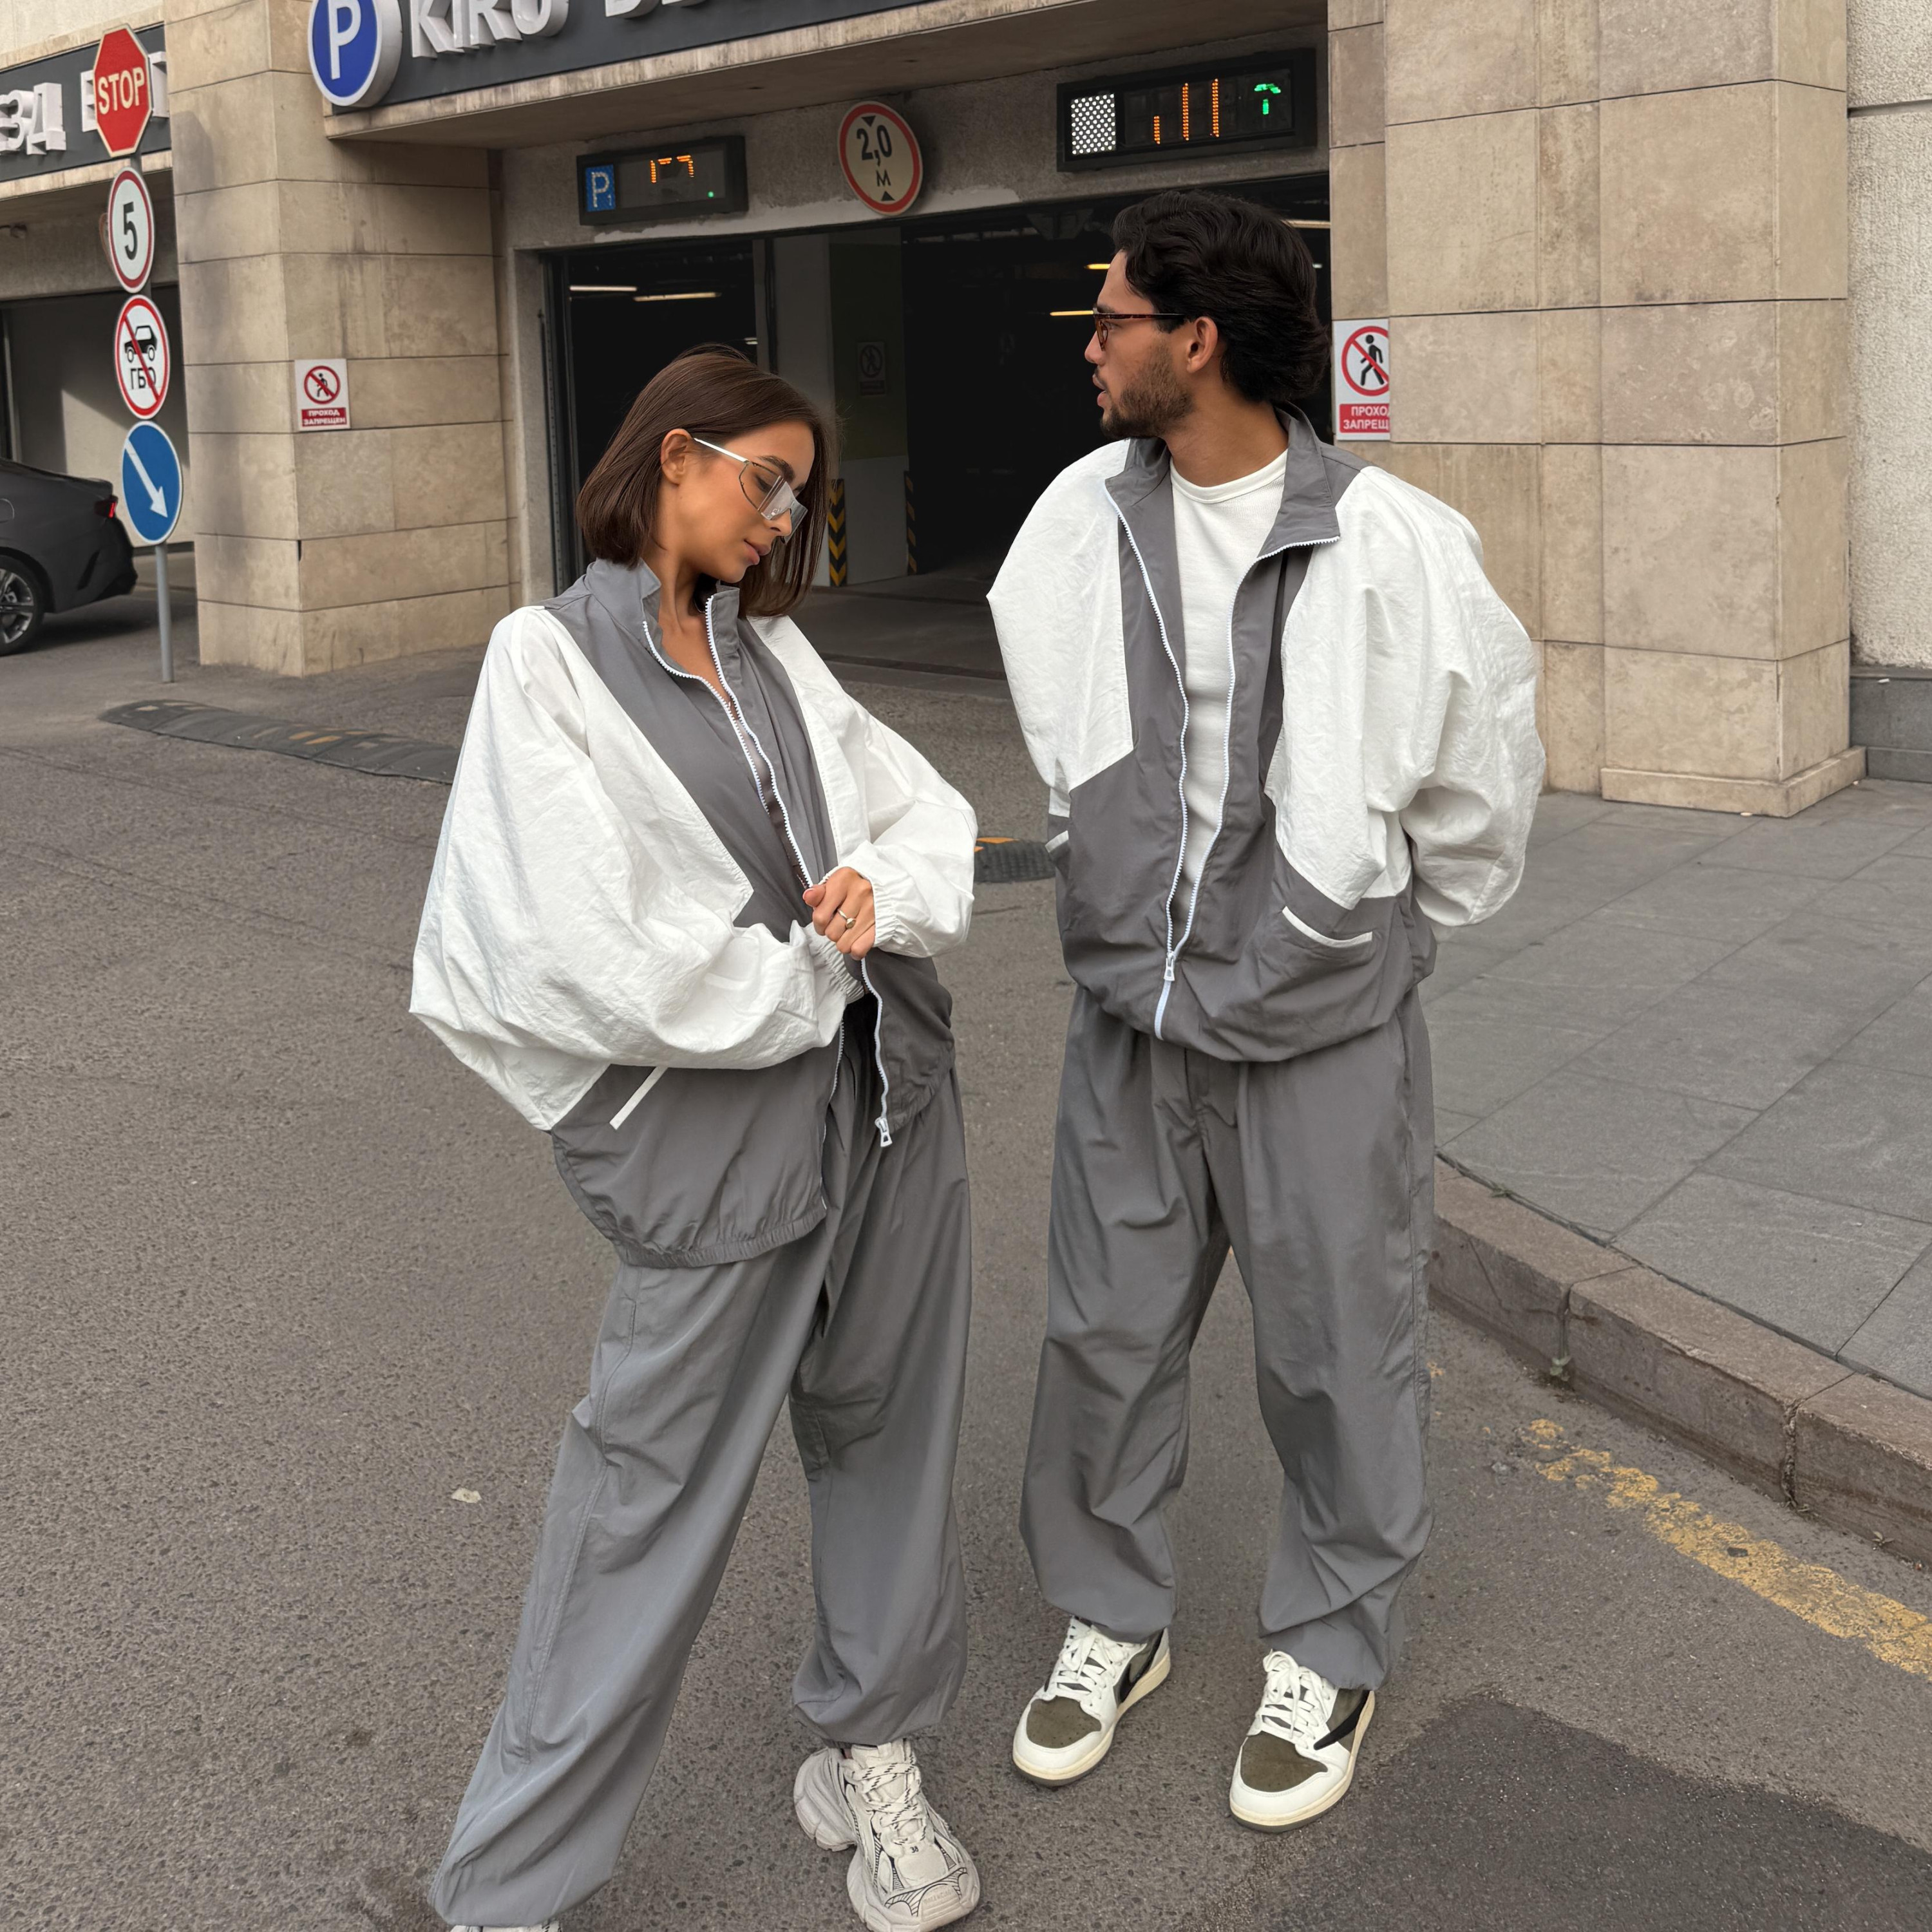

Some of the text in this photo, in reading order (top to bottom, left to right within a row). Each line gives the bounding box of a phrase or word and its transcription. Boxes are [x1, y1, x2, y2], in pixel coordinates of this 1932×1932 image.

[328, 0, 362, 80] P
[98, 66, 145, 115] STOP
[0, 82, 66, 155] ЗД
[857, 125, 893, 167] 2,0
[591, 171, 611, 208] P
[876, 169, 892, 187] М
[122, 202, 138, 261] 5
[130, 366, 156, 390] ГБО
[308, 409, 341, 417] ПРОХОД
[1343, 419, 1388, 430] ЗАПРЕЩ
[1351, 405, 1390, 416] ПРОХО
